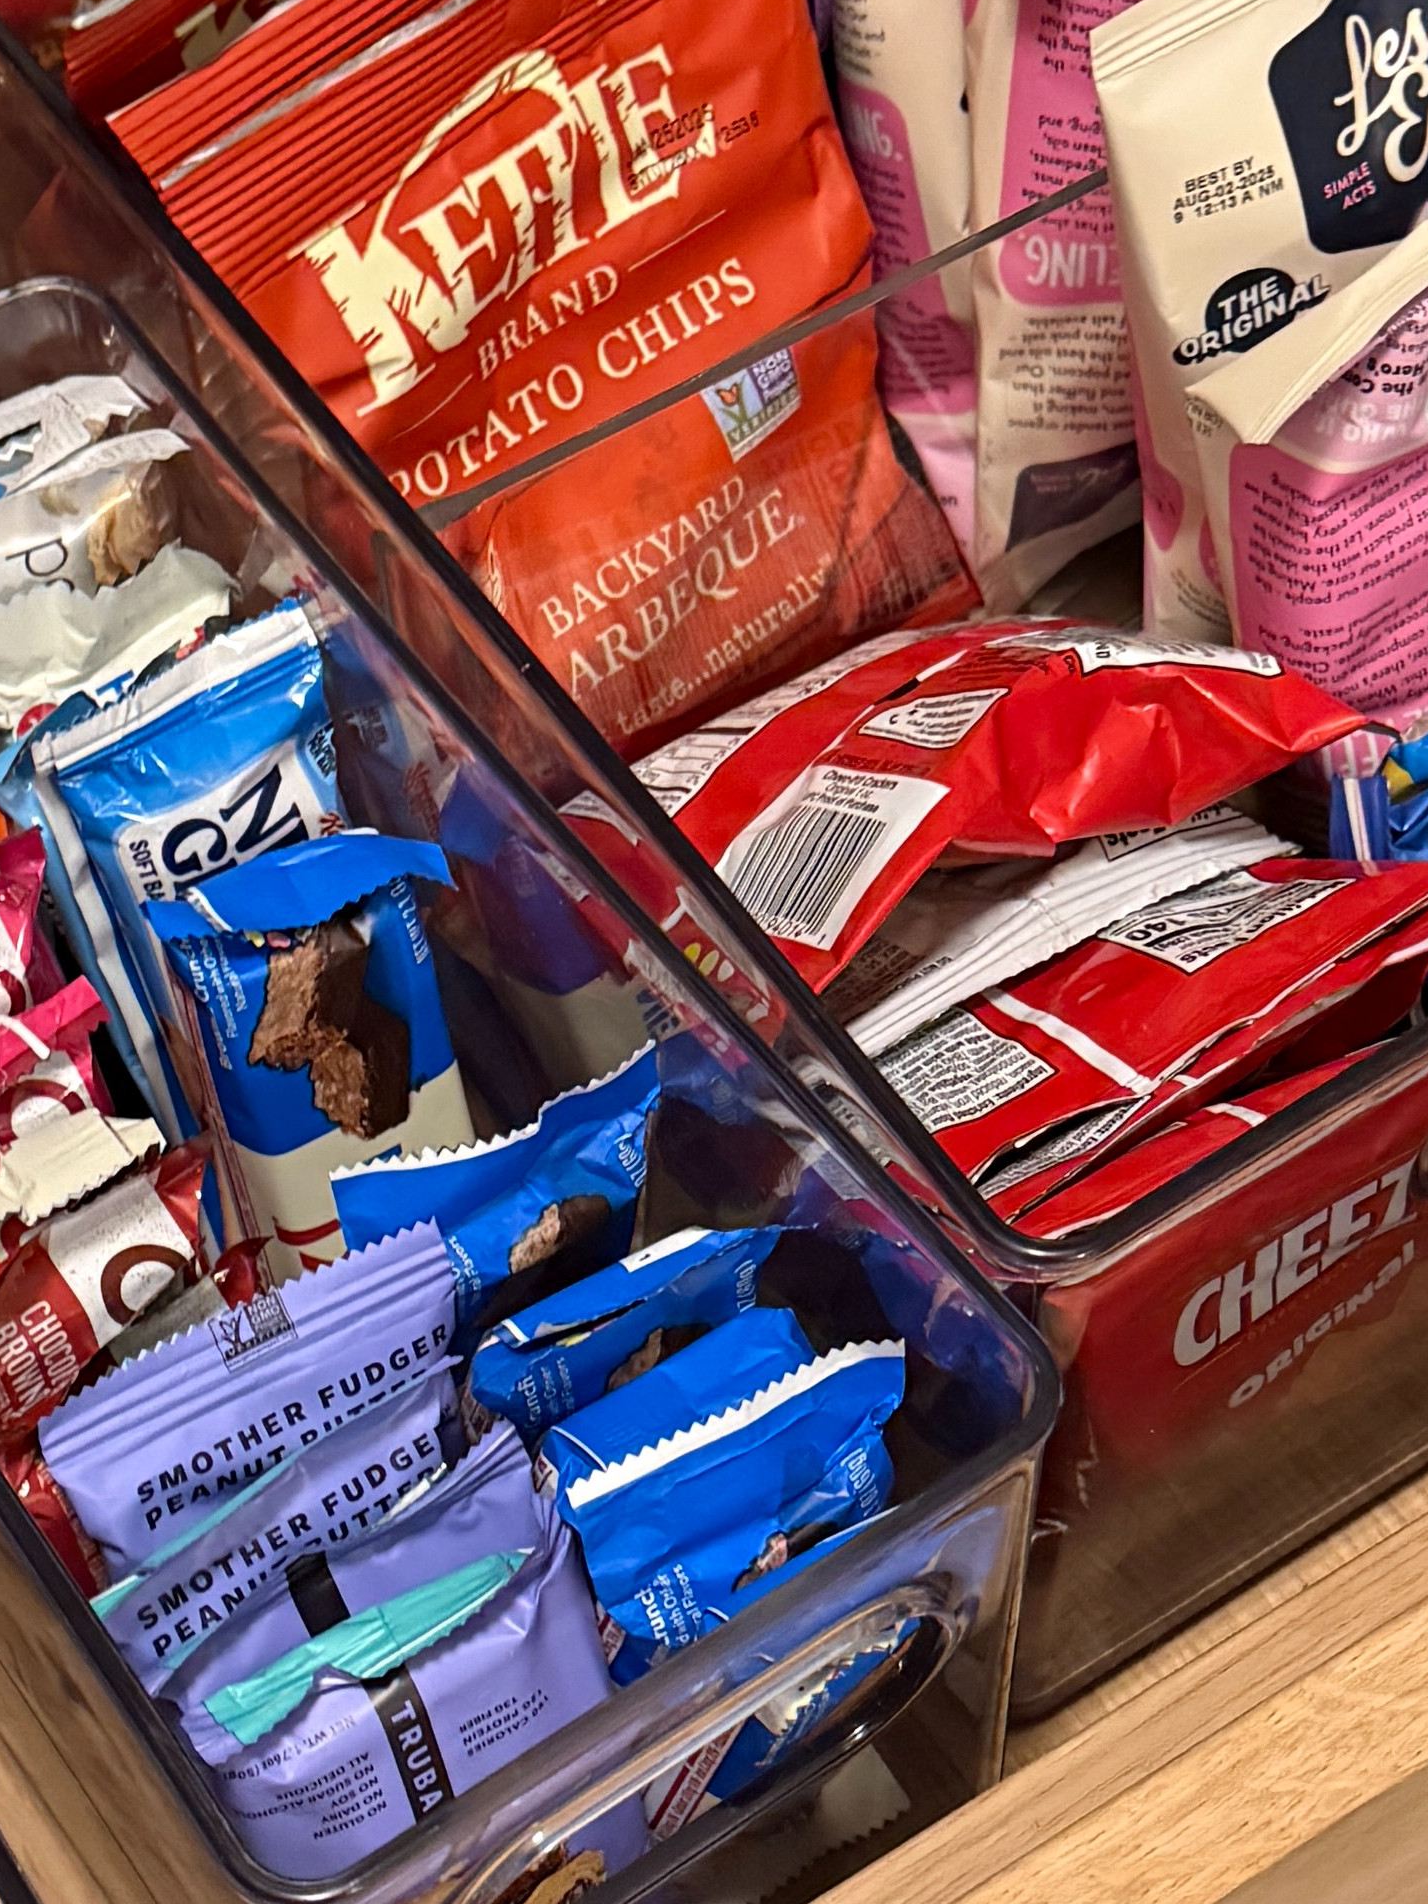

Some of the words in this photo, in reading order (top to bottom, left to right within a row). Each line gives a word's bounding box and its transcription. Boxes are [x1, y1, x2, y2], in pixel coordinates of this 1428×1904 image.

[1172, 165, 1277, 212] AUG-02-2025
[1183, 163, 1229, 194] BEST
[1230, 156, 1255, 182] BY
[1322, 161, 1372, 200] SIMPLE
[1340, 178, 1378, 211] ACTS
[1216, 273, 1283, 315] THE
[477, 260, 619, 382] BRAND
[1178, 274, 1334, 363] ORIGINAL
[390, 361, 584, 507] POTATO
[596, 255, 757, 381] CHIPS
[538, 474, 746, 641] BACKYARD
[568, 488, 799, 700] ARBEQUE
[128, 838, 155, 880] SOFT
[1123, 907, 1186, 947] 140
[16, 1297, 84, 1390] CHOCOL
[131, 1397, 310, 1506] SMOTHER
[314, 1321, 453, 1411] FUDGER
[140, 1442, 292, 1531] PEANUT
[133, 1508, 314, 1632] SMOTHER
[316, 1431, 438, 1517] FUDGE
[351, 1762, 375, 1782] NO
[388, 1700, 440, 1815] TRUBA
[273, 1763, 346, 1804] DELICIOUS
[304, 1775, 351, 1804] SUGAR
[356, 1775, 379, 1795] NO
[360, 1787, 384, 1807] NO
[310, 1811, 365, 1841] GLUTEN
[364, 1799, 388, 1819] NO
